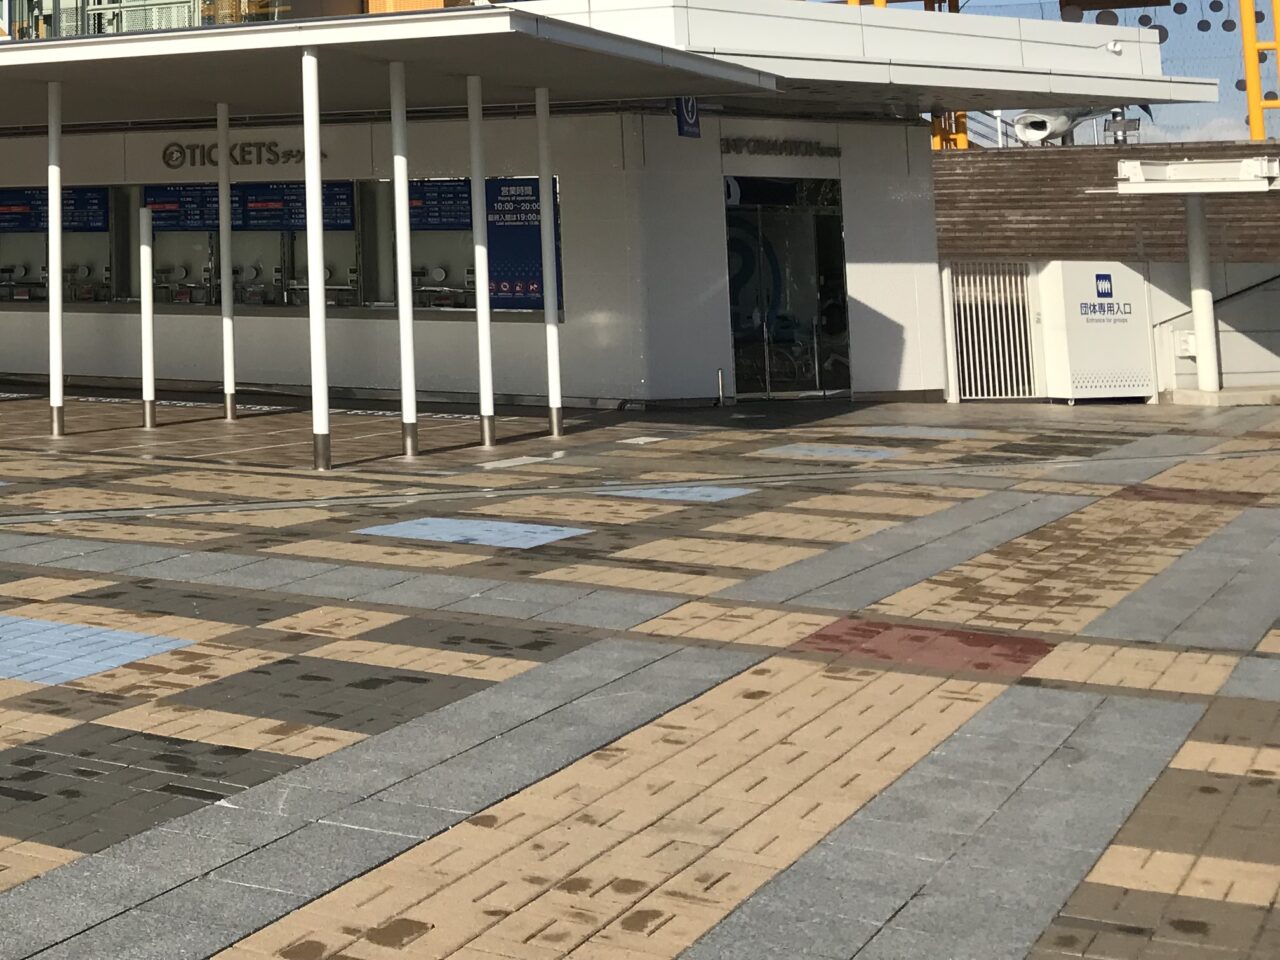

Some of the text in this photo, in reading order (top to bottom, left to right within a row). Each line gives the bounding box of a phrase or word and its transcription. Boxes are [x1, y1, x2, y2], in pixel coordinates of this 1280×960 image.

[185, 141, 280, 167] TICKETS
[1080, 302, 1132, 316] 団体専用入口
